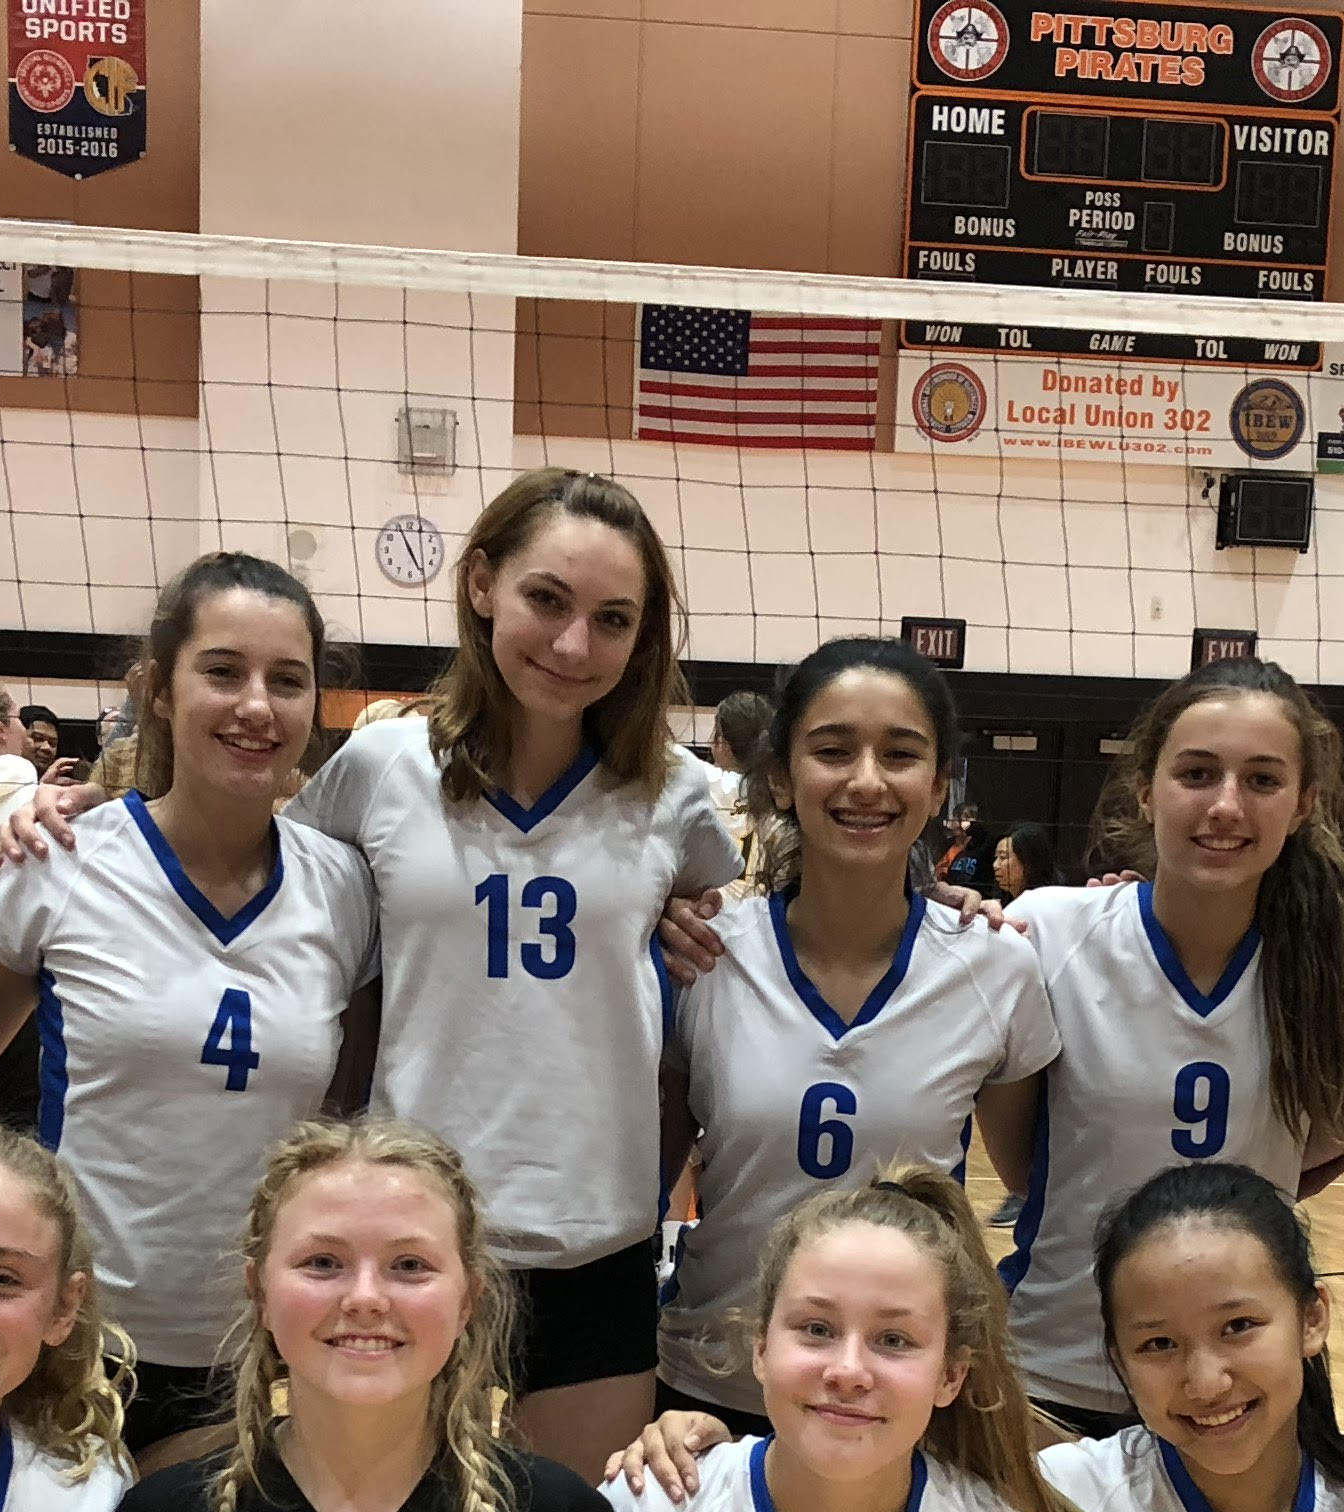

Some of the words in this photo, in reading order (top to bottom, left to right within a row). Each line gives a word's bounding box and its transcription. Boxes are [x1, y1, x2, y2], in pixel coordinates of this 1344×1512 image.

[21, 0, 130, 20] UNIFIED
[25, 17, 128, 44] SPORTS
[1030, 12, 1234, 54] PITTSBURG
[1055, 48, 1205, 86] PIRATES
[36, 123, 118, 139] ESTABLISHED
[932, 105, 1006, 136] HOME
[36, 138, 118, 158] 2015-2016
[1233, 125, 1330, 157] VISITOR
[1085, 191, 1121, 207] POSS
[954, 216, 1016, 239] BONUS
[1068, 208, 1135, 231] PERIOD
[1223, 232, 1284, 255] BONUS
[918, 251, 976, 273] FOULS
[1051, 258, 1119, 281] PLAYER
[1145, 264, 1202, 286] FOULS
[1258, 270, 1314, 293] FOULS
[924, 325, 962, 343] WON
[998, 328, 1032, 348] TOL
[1089, 333, 1136, 352] GAME
[1195, 339, 1228, 360] TOL
[1264, 343, 1301, 361] WON
[1042, 368, 1143, 396] Donated
[1152, 374, 1180, 403] by
[1007, 400, 1076, 426] Local
[1085, 403, 1154, 429] Union
[1163, 408, 1212, 432] 302
[1245, 413, 1294, 430] IBEW
[1003, 437, 1213, 456] www.IBEWLU302.com
[917, 629, 953, 656] EXIT
[476, 874, 577, 979] 13
[202, 989, 260, 1091] 4
[1172, 1062, 1230, 1158] 9
[799, 1082, 857, 1178] 6
